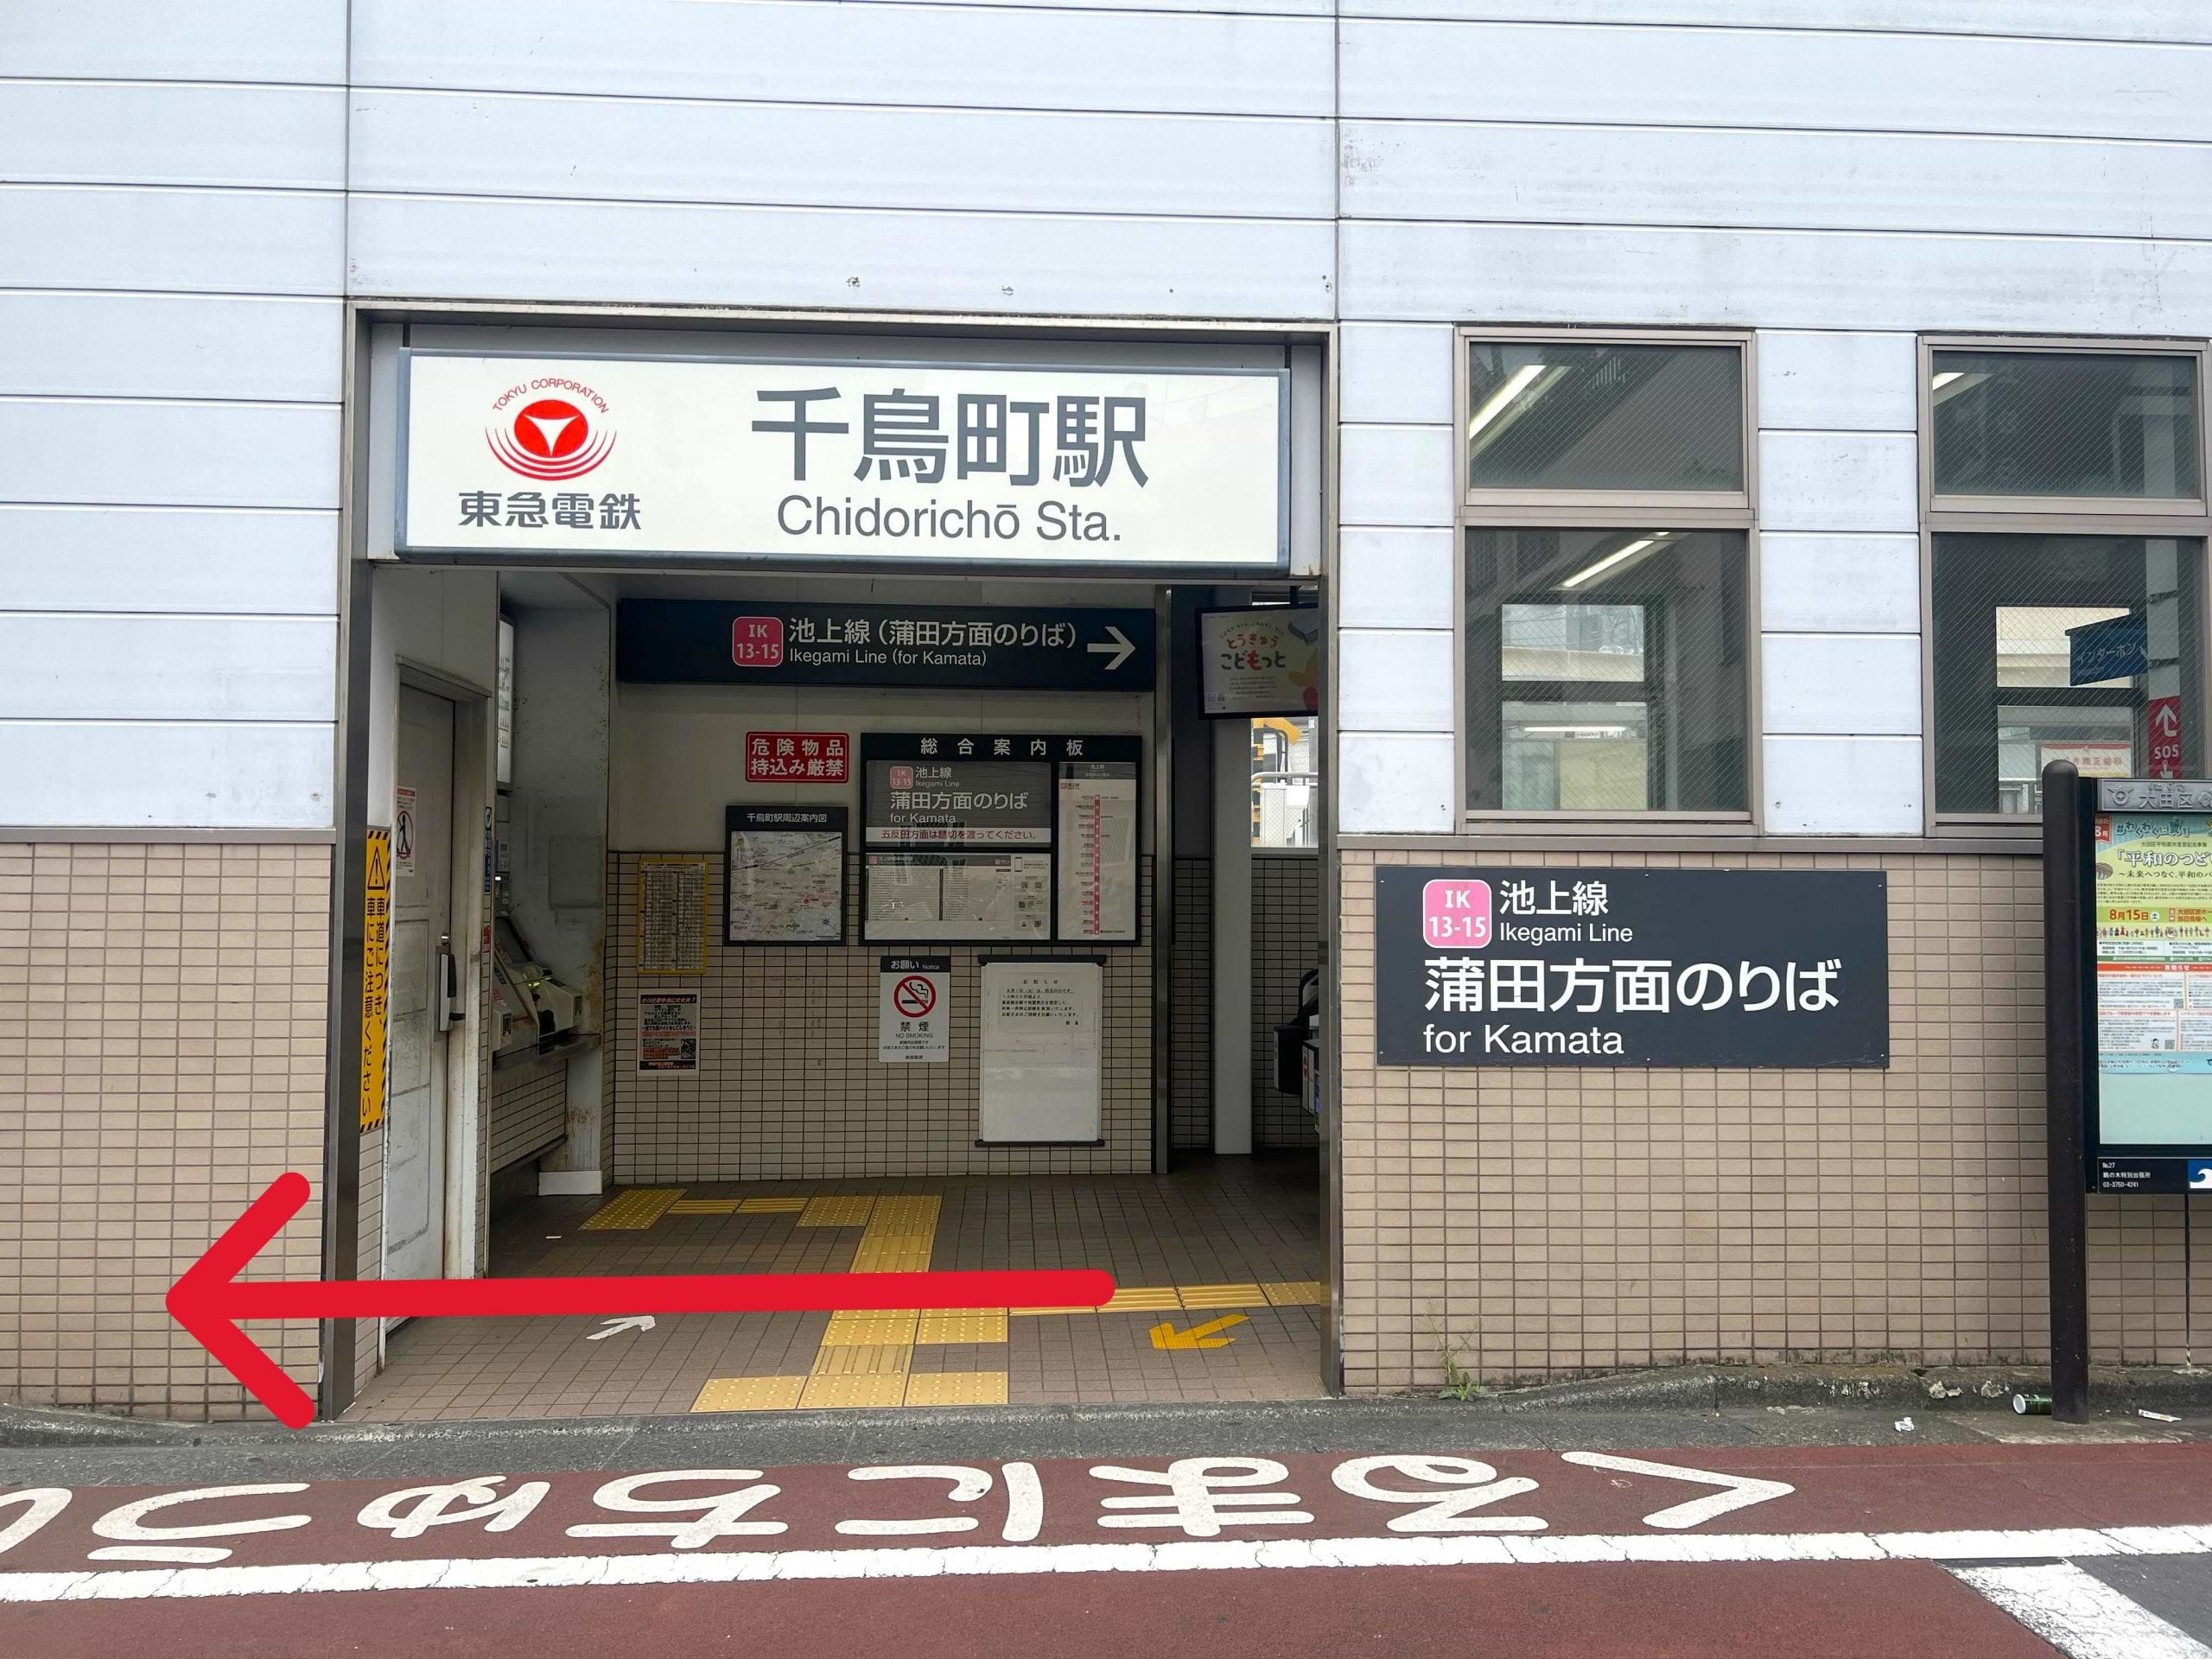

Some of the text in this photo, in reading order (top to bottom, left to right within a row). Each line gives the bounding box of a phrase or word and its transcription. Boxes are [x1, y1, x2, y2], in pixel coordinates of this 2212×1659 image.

[493, 378, 609, 413] TOKYU CORPORATION
[751, 386, 1149, 488] 千鳥町駅
[457, 489, 642, 531] 東急電鉄
[777, 494, 1122, 543] Chidorichō Sta.
[748, 623, 768, 639] IK
[1227, 632, 1279, 649] とうきゅう
[735, 643, 779, 660] 13-15
[790, 650, 987, 666] Ikegami Line (for Kamata)
[1221, 650, 1286, 671] こどもっと
[752, 738, 843, 756] 危険物品
[920, 737, 1084, 756] 総合案内板
[2154, 744, 2179, 760] SOS
[751, 758, 844, 776] 持込み厳禁
[915, 766, 952, 779] 池上線
[915, 779, 944, 788] Ikegami
[890, 791, 1029, 810] 蒲田方面のりば
[2139, 791, 2194, 810] 大田区
[747, 812, 827, 823] 千鳥町駅周辺案内図
[889, 813, 957, 823] for Kamata
[881, 829, 1038, 841] 五反田方面は踏切を渡ってください。
[1444, 889, 1471, 910] IK
[1498, 880, 1609, 917] 池上線
[2109, 909, 2149, 920] 8月15日
[1428, 915, 1487, 939] 13-15
[1499, 923, 1633, 947] Ikegami Line
[374, 897, 385, 1026] 車道につき、
[891, 959, 919, 969] お願い
[1424, 956, 1843, 1014] 蒲田方面のりば
[361, 897, 376, 1117] 車にご注意ください
[900, 1021, 930, 1032] 禁煙
[1422, 1025, 1624, 1055] for Kamata
